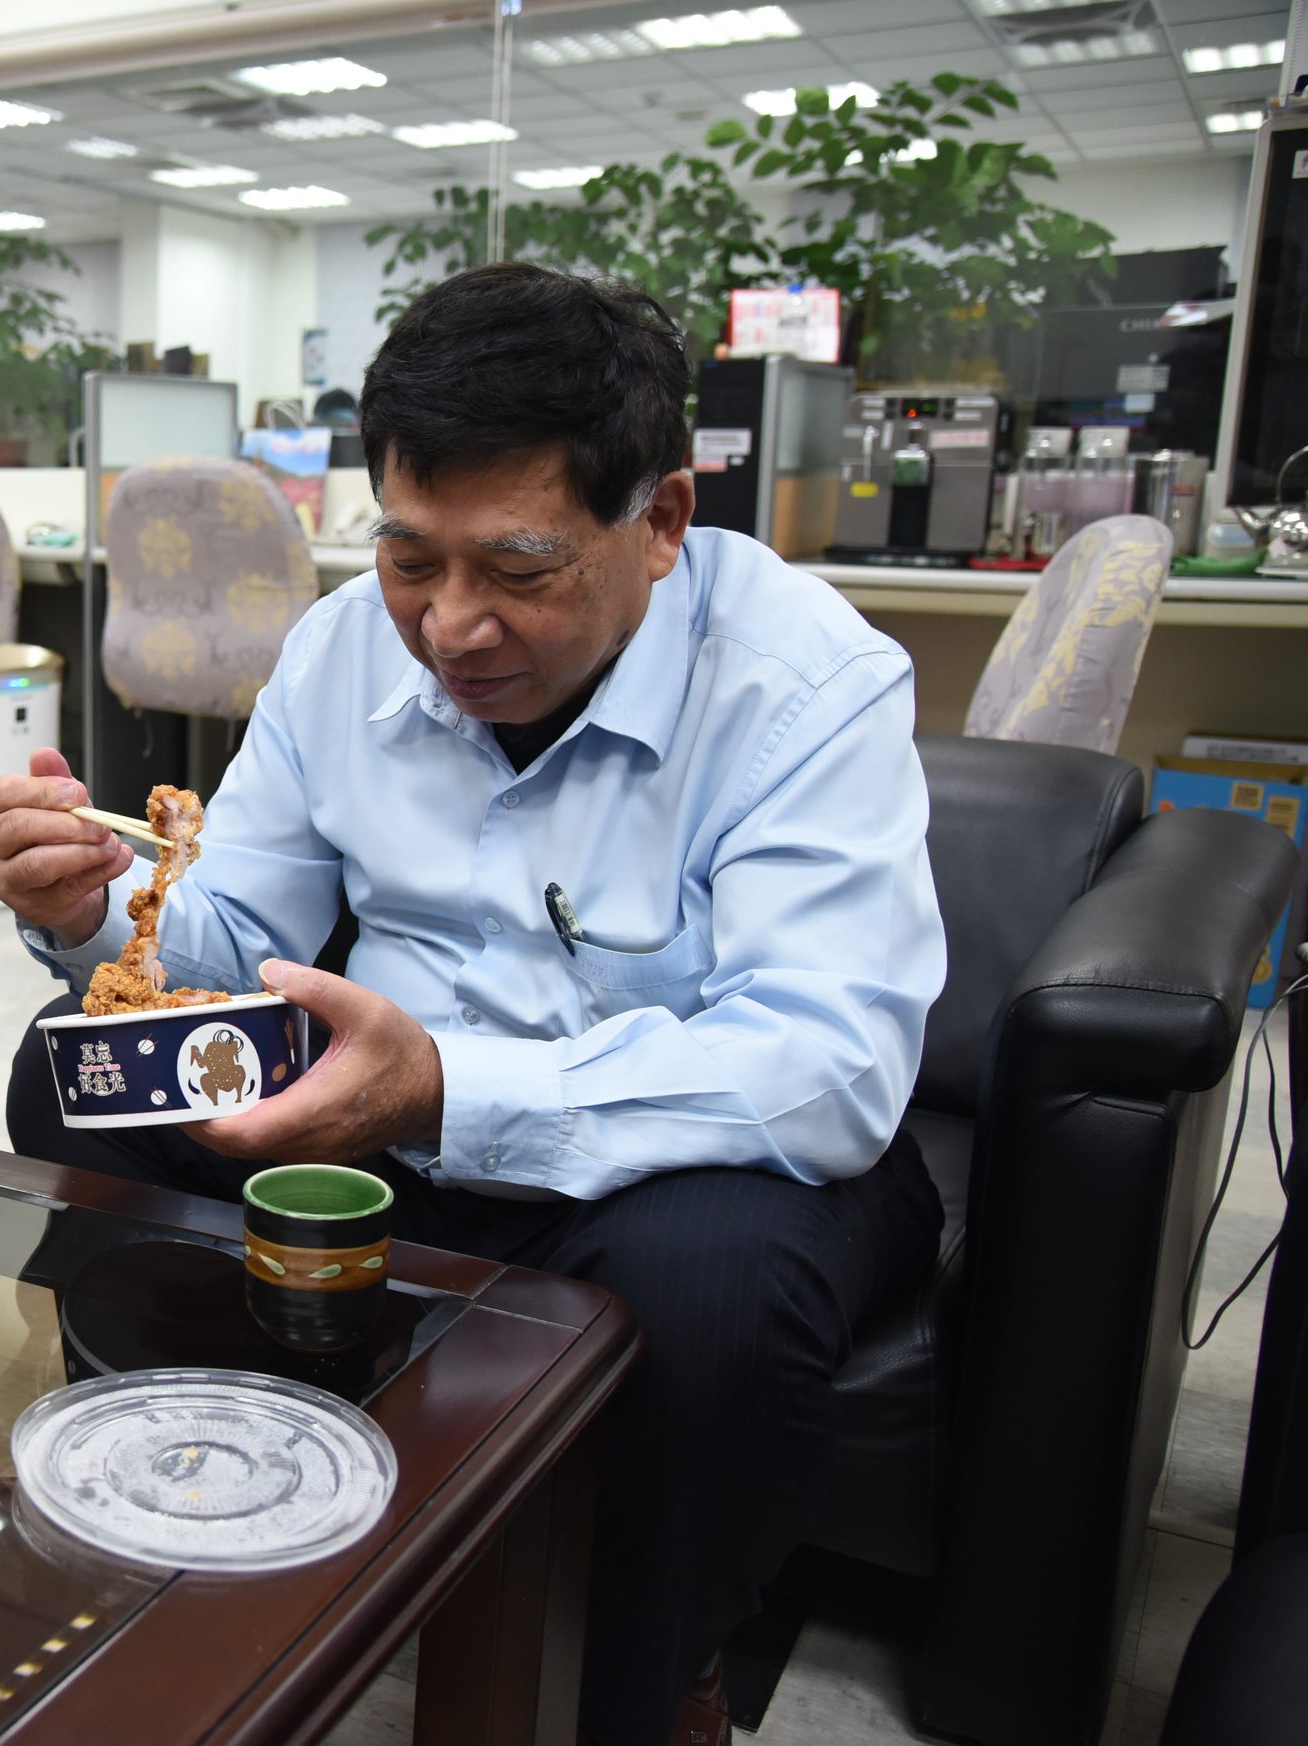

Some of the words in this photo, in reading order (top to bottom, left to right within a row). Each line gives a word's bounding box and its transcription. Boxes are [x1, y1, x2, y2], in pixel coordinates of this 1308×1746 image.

[80, 1040, 113, 1064] 莫忘
[78, 1071, 127, 1096] 好食光
